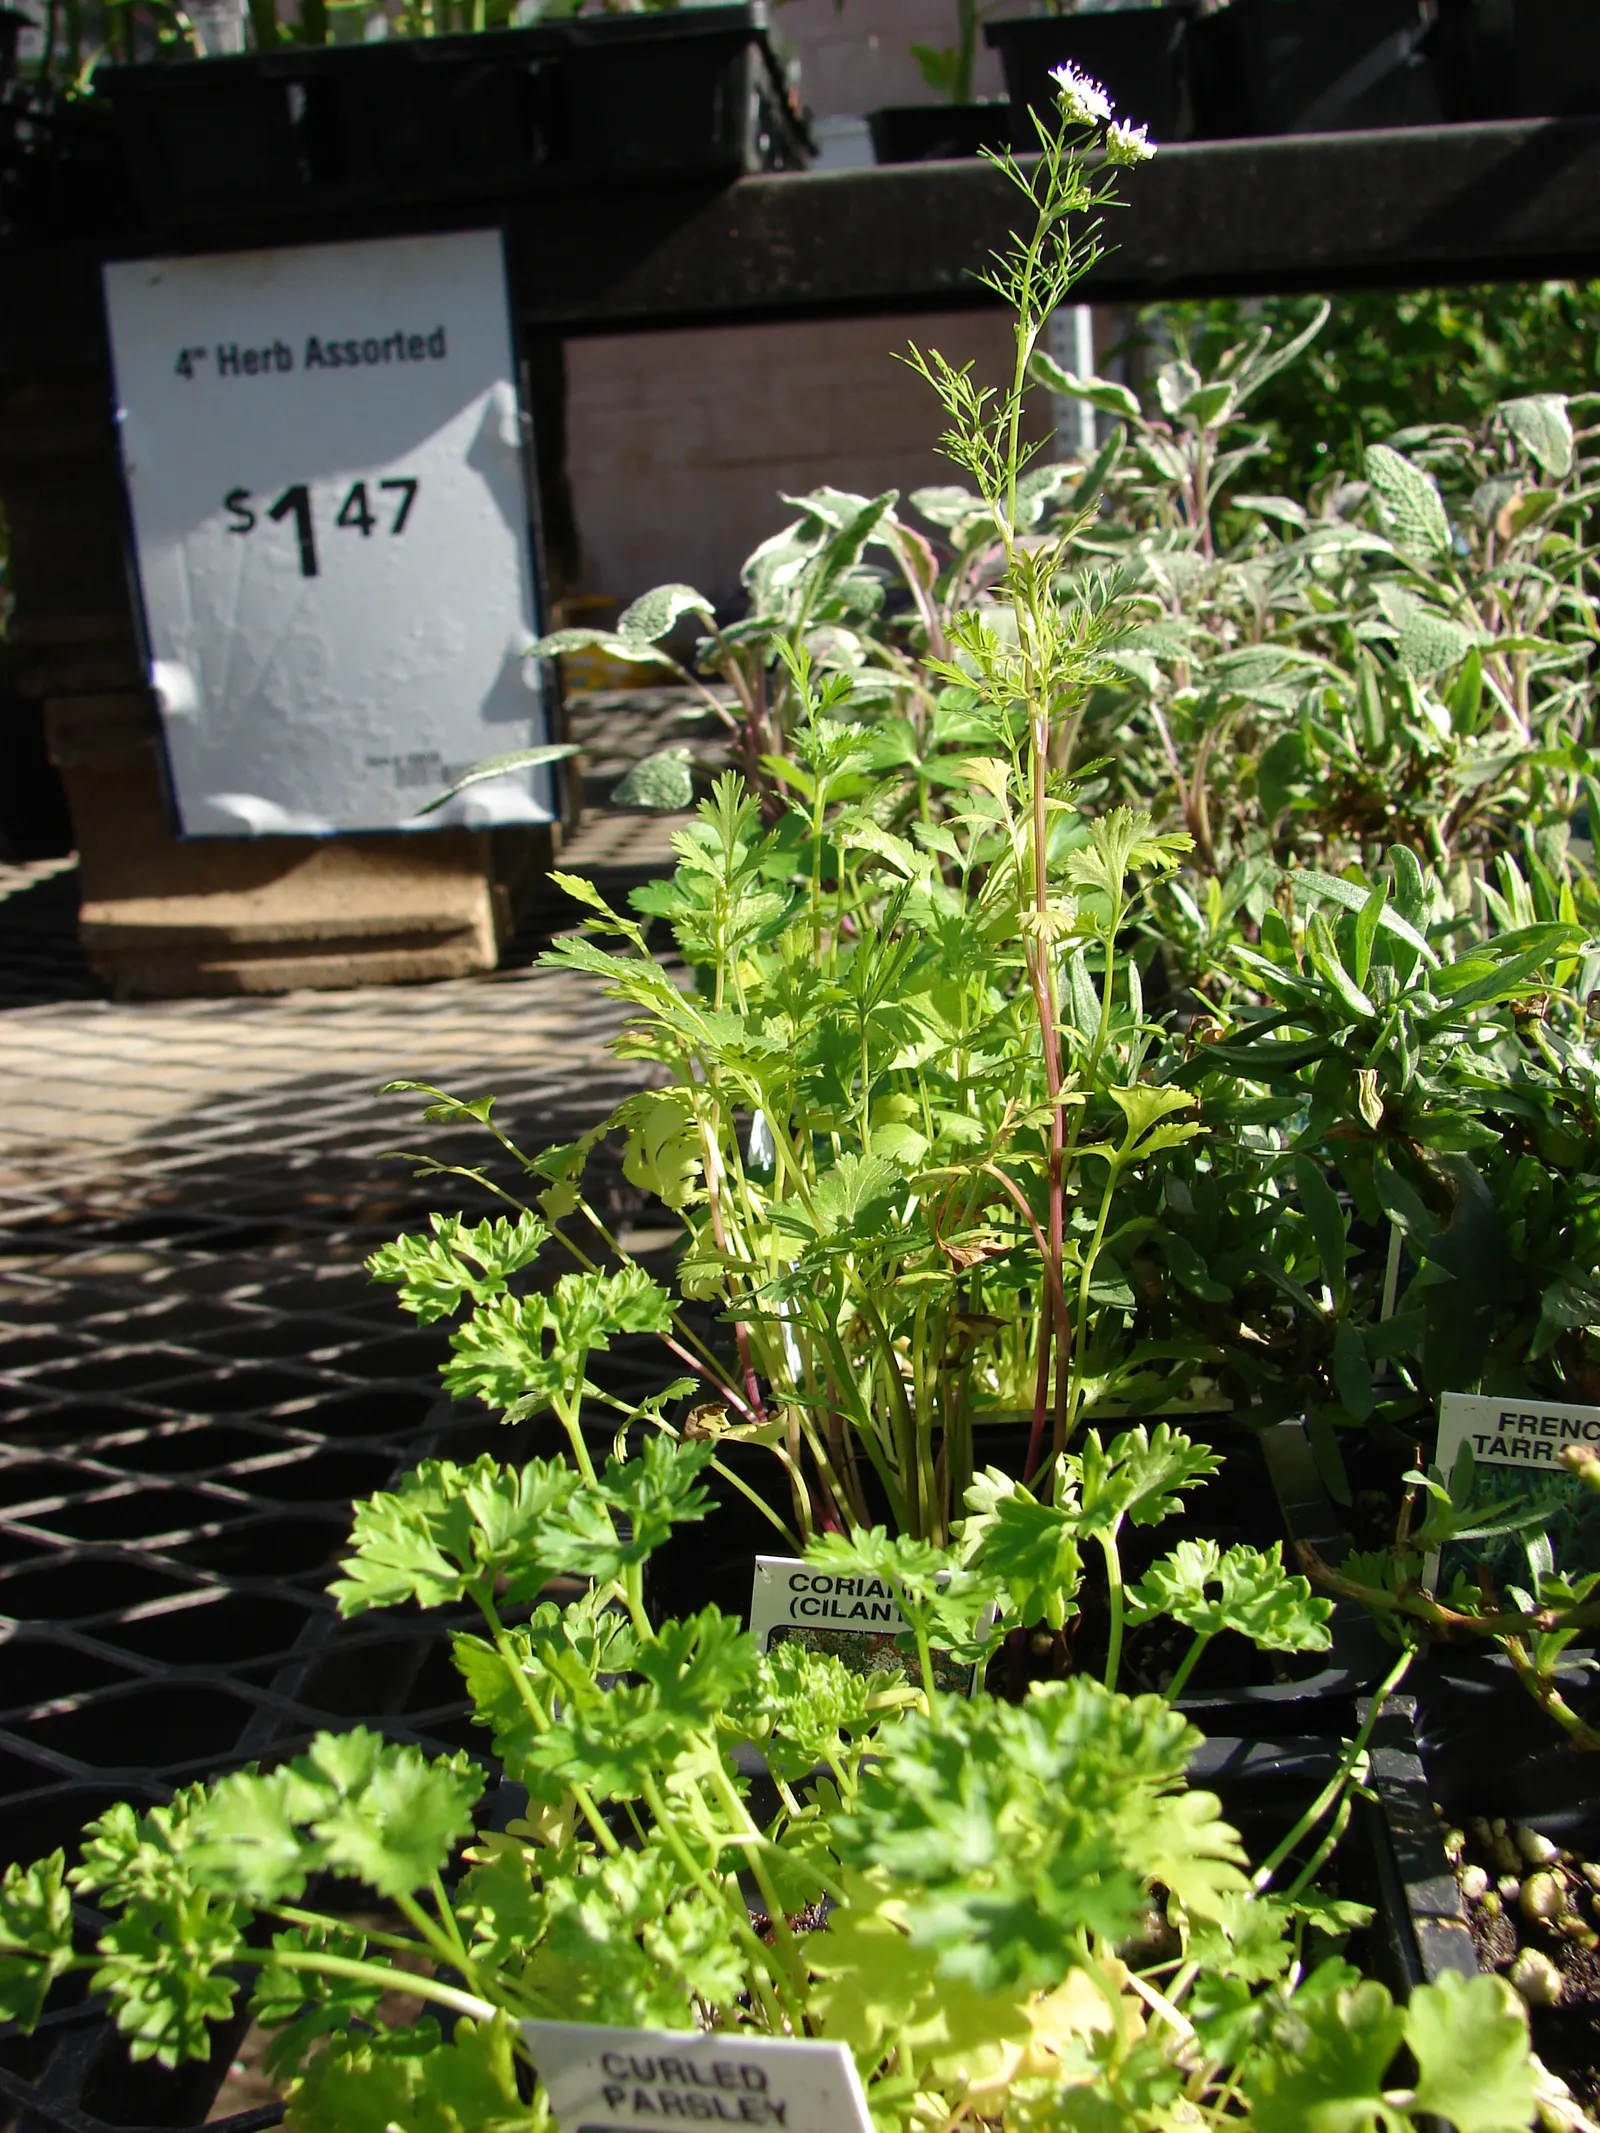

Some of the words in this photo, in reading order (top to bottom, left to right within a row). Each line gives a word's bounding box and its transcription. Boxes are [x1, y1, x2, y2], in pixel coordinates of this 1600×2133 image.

[217, 337, 294, 377] Herb
[304, 324, 448, 370] Assorted
[601, 2052, 769, 2094] CURLED
[601, 2083, 788, 2128] PARSLEY
